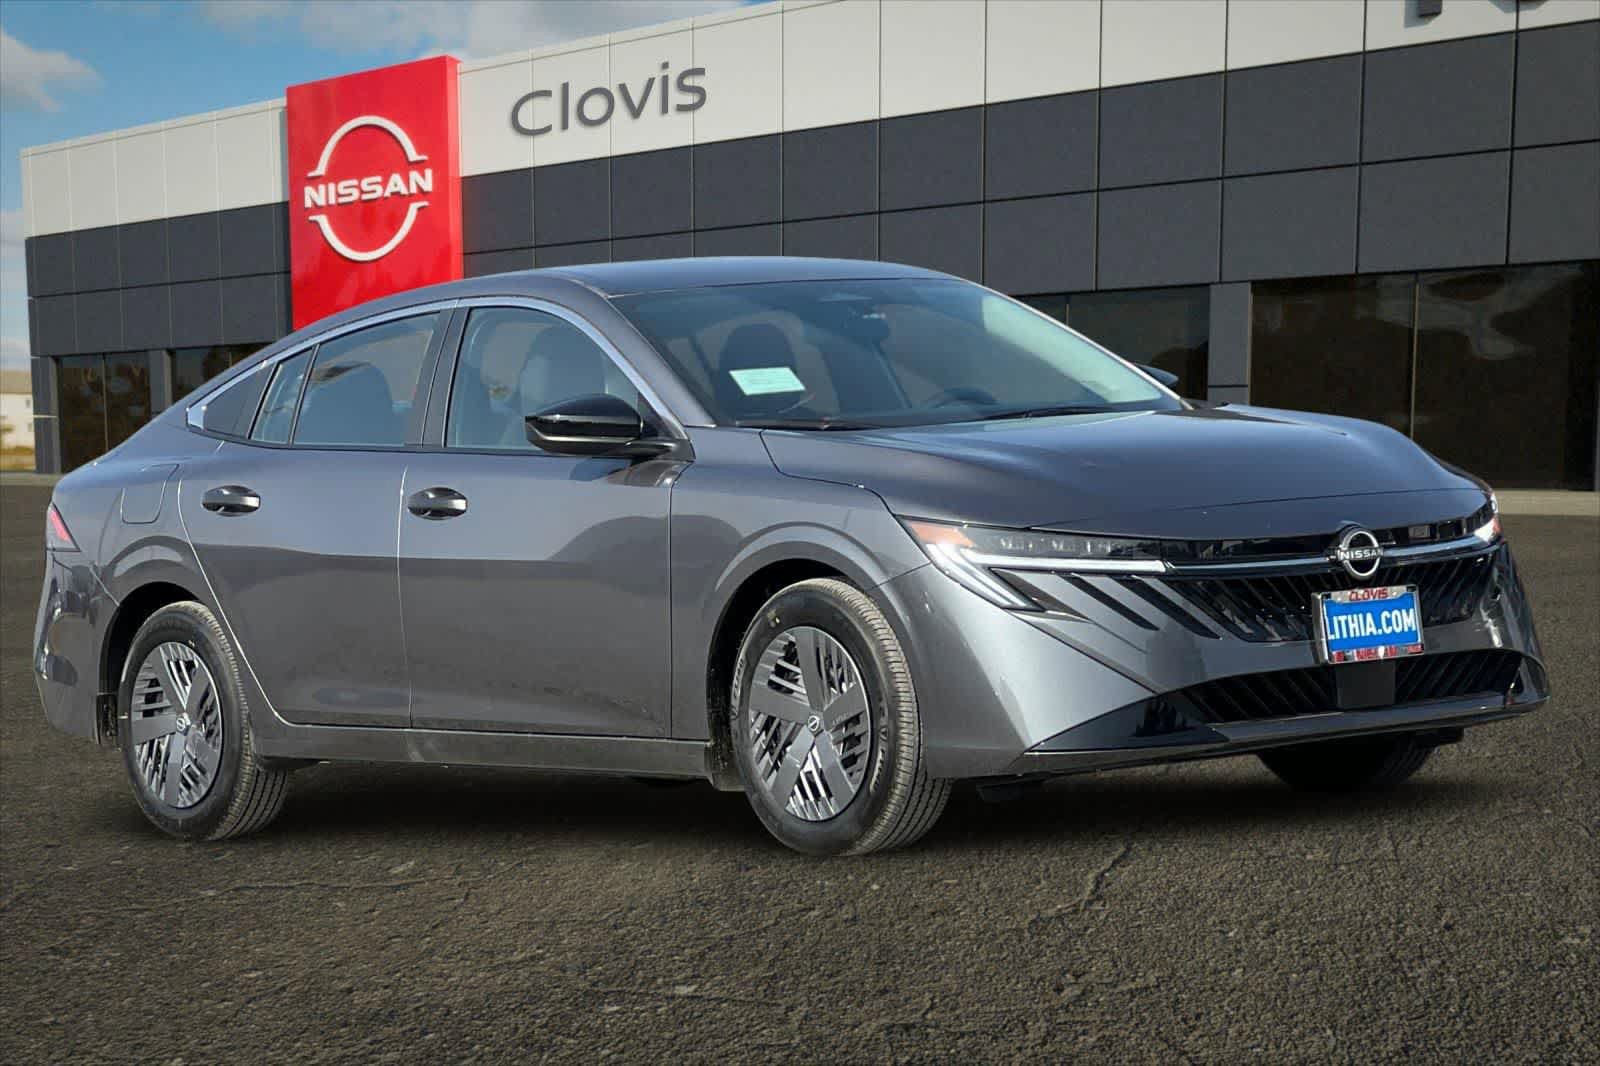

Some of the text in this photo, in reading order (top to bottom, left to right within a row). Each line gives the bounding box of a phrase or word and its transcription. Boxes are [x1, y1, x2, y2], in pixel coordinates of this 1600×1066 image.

[511, 62, 707, 136] Clovis
[304, 168, 434, 209] NISSAN
[1337, 548, 1383, 561] NISSAN
[1349, 588, 1388, 601] CLOVIS
[1327, 608, 1417, 640] LITHIA.COM
